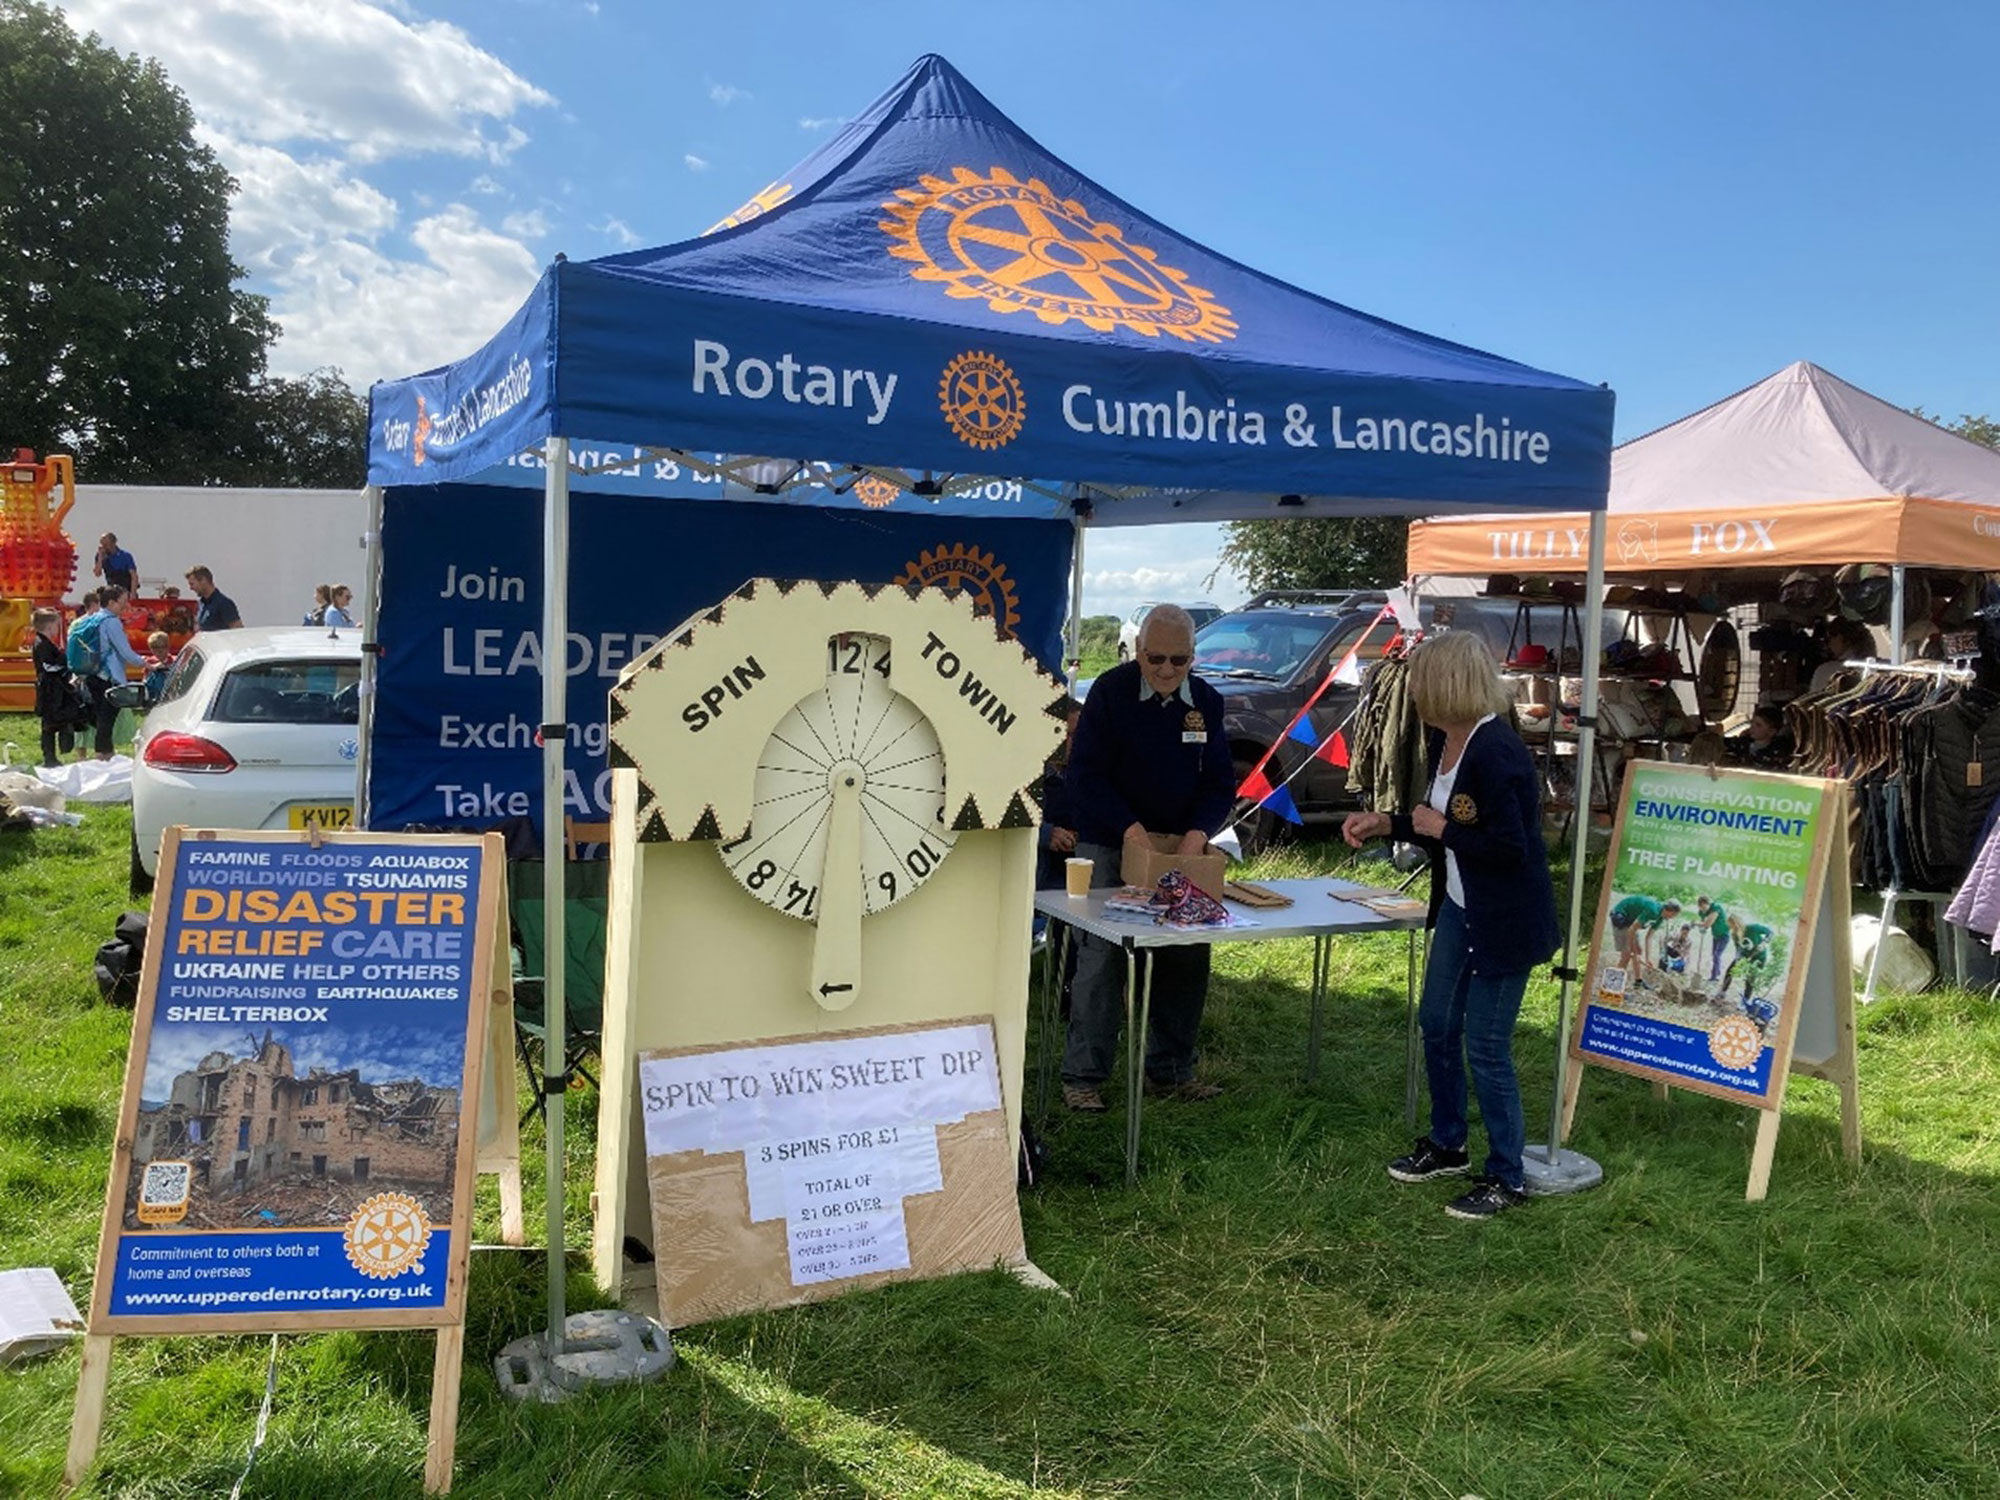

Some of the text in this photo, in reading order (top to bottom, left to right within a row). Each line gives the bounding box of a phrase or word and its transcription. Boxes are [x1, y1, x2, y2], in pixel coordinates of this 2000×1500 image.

[951, 186, 1078, 218] ROTARY
[693, 339, 1551, 464] Rotary Cumbria & Lancashire
[1487, 518, 1779, 560] TILLY FOX
[440, 565, 525, 602] Join
[927, 560, 984, 577] ROTARY
[828, 640, 861, 674] 12
[682, 655, 767, 734] SPIN
[436, 783, 530, 818] Take
[1639, 783, 1813, 815] CONSERVATION
[302, 808, 351, 827] KV12
[1635, 801, 1808, 837] ENVIRONMENT
[188, 852, 469, 870] FAMINE FLOODS AQUABOX
[747, 859, 777, 890] 8
[1628, 848, 1797, 889] TREE PLANTING
[187, 870, 468, 889] WORLDWIDE TSUNAMIS
[182, 889, 467, 925] DISASTER
[177, 930, 462, 959] RELIEF CARE
[173, 963, 460, 981] UKRAINE HELP OTHERS
[169, 986, 459, 1000] FUNDRAISING EARTHQUAKES
[167, 1006, 328, 1023] SHELTERBOX
[646, 1049, 983, 1112] SPIN TO WIN SWEET DIP
[761, 1128, 900, 1163] 3 SPINS FOR £1
[805, 1174, 872, 1195] TOTAL OF
[822, 1203, 841, 1218] OR
[844, 1197, 882, 1214] OVER
[130, 1244, 320, 1261] Commitment to others both at
[127, 1266, 252, 1280] home and overseas
[125, 1283, 432, 1307] www.upperedenrotary.org.uk
